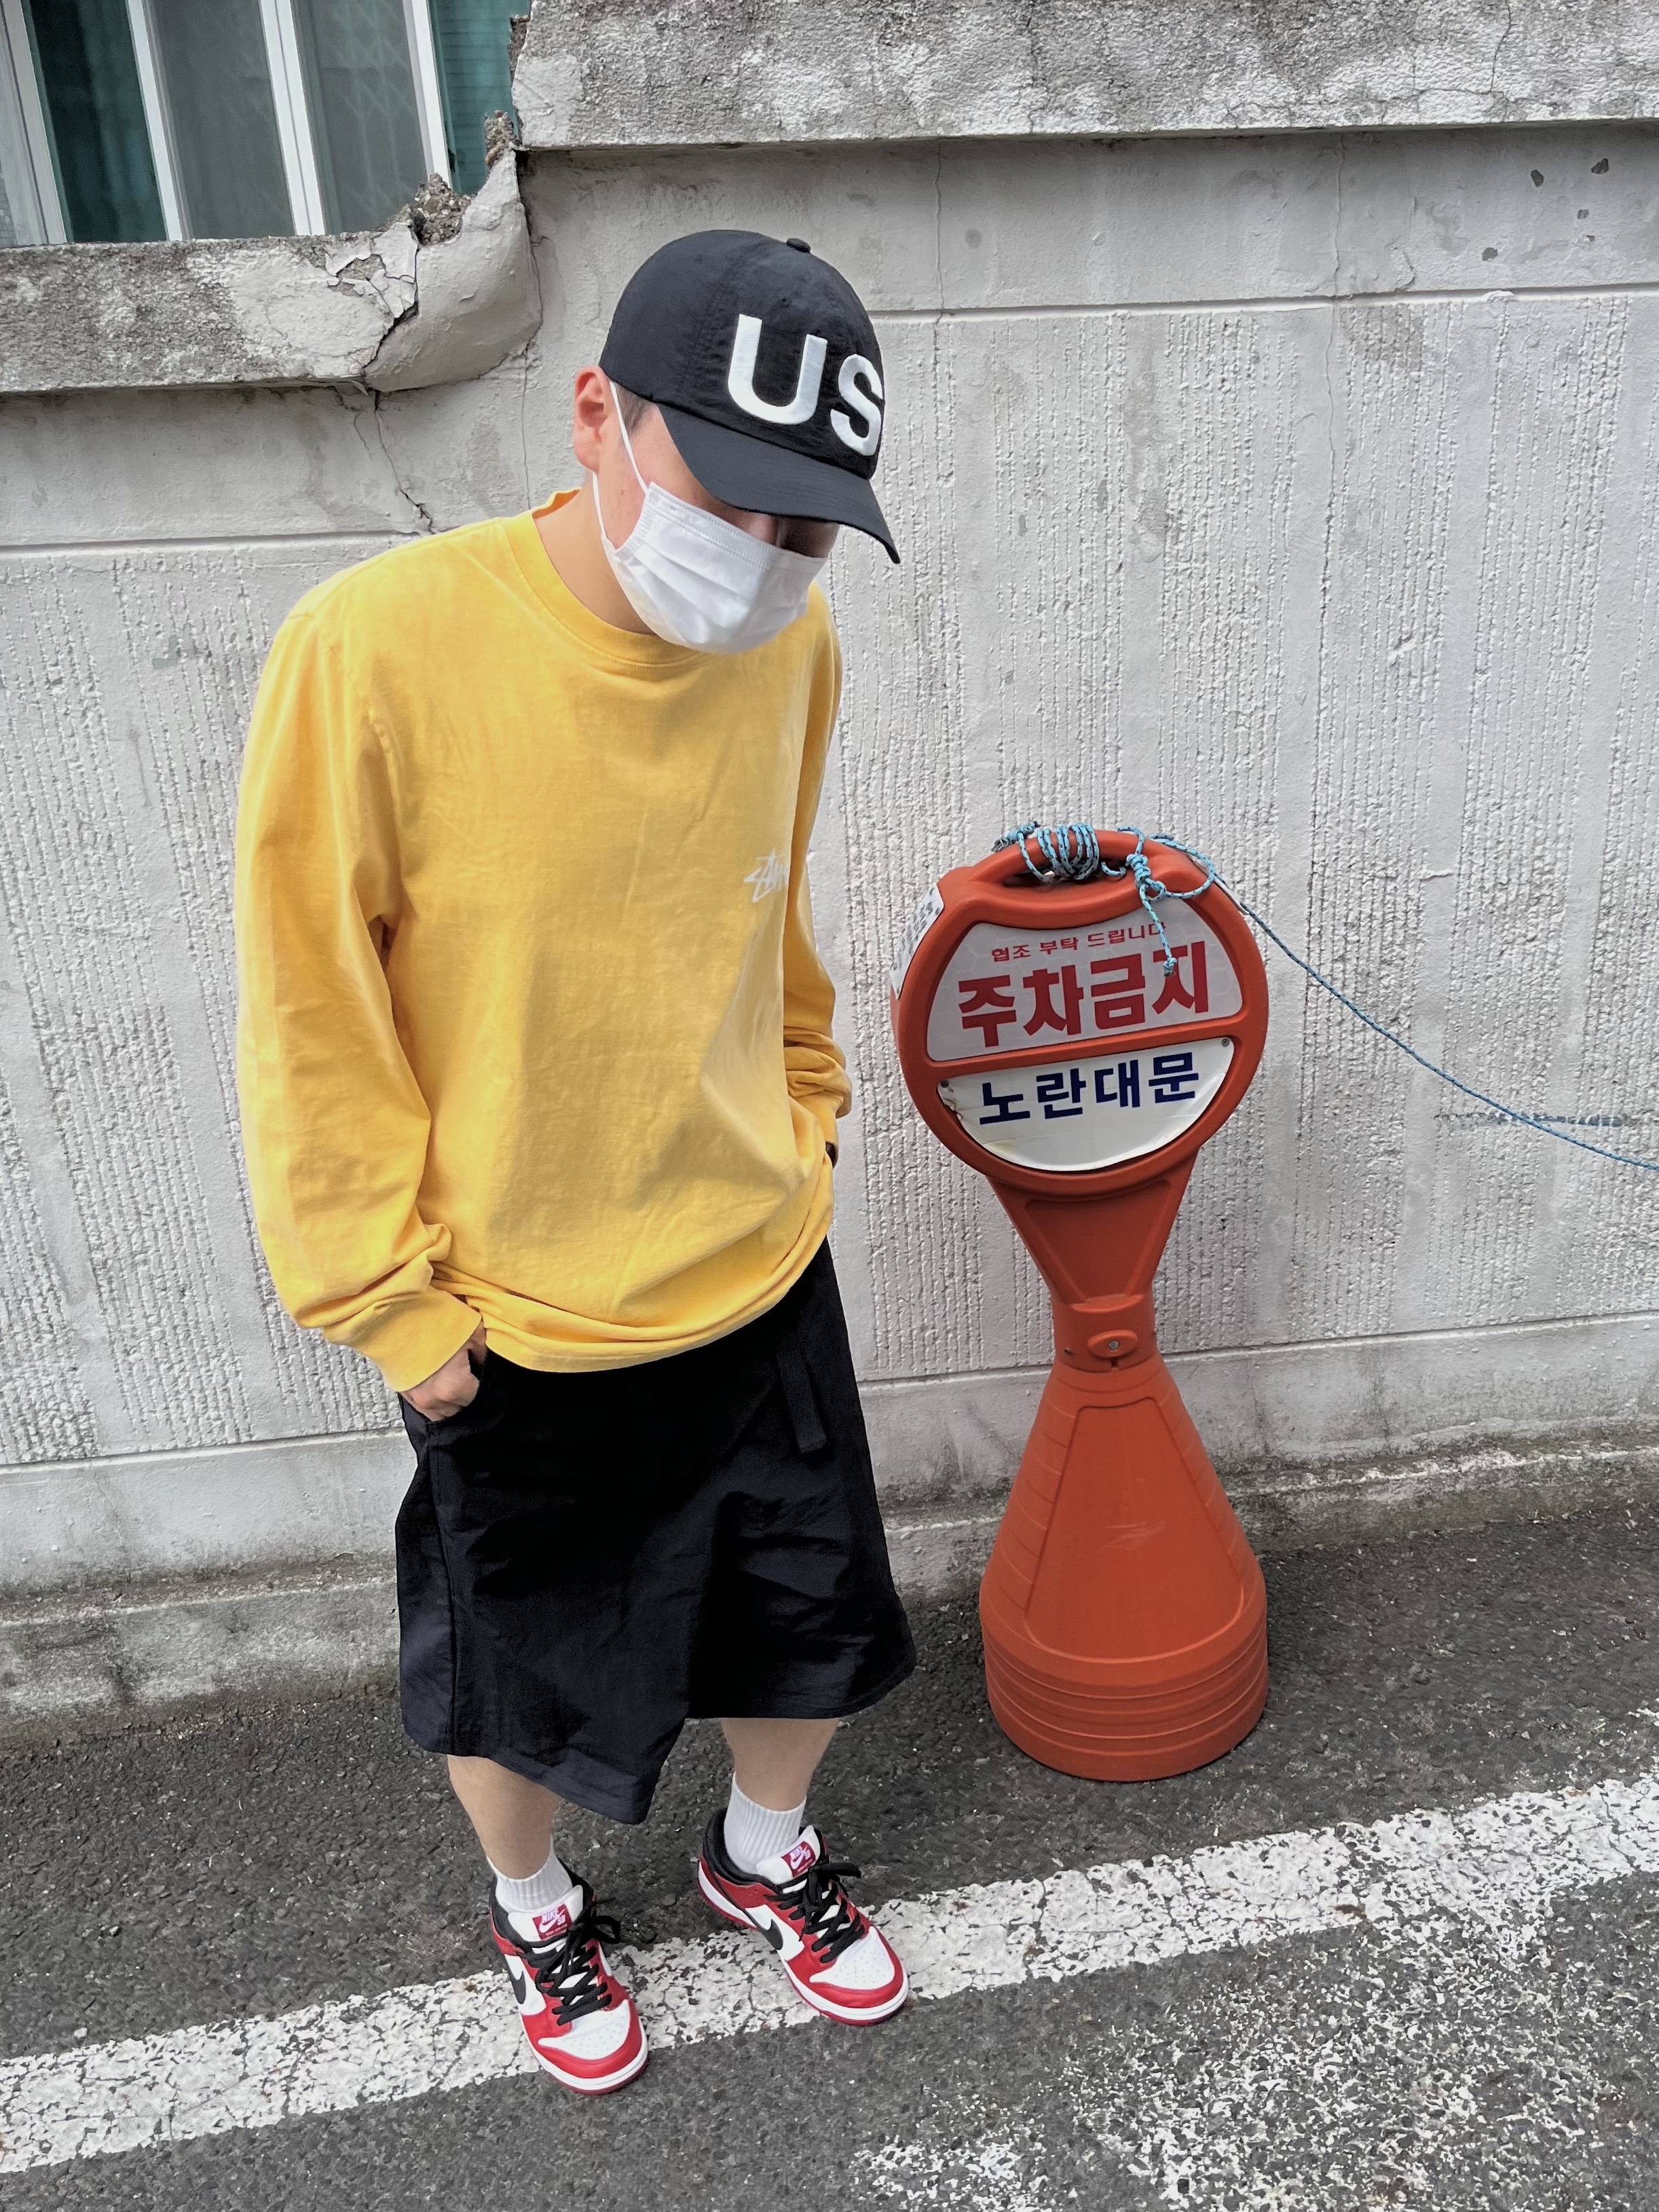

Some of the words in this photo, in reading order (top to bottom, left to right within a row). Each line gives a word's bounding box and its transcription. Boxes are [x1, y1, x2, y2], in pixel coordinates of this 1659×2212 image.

[991, 944, 1031, 962] 협조
[1040, 937, 1079, 955] 부탁
[1087, 921, 1166, 947] 드립니다
[958, 940, 1209, 1048] 주차금지
[979, 1052, 1199, 1125] 노란대문
